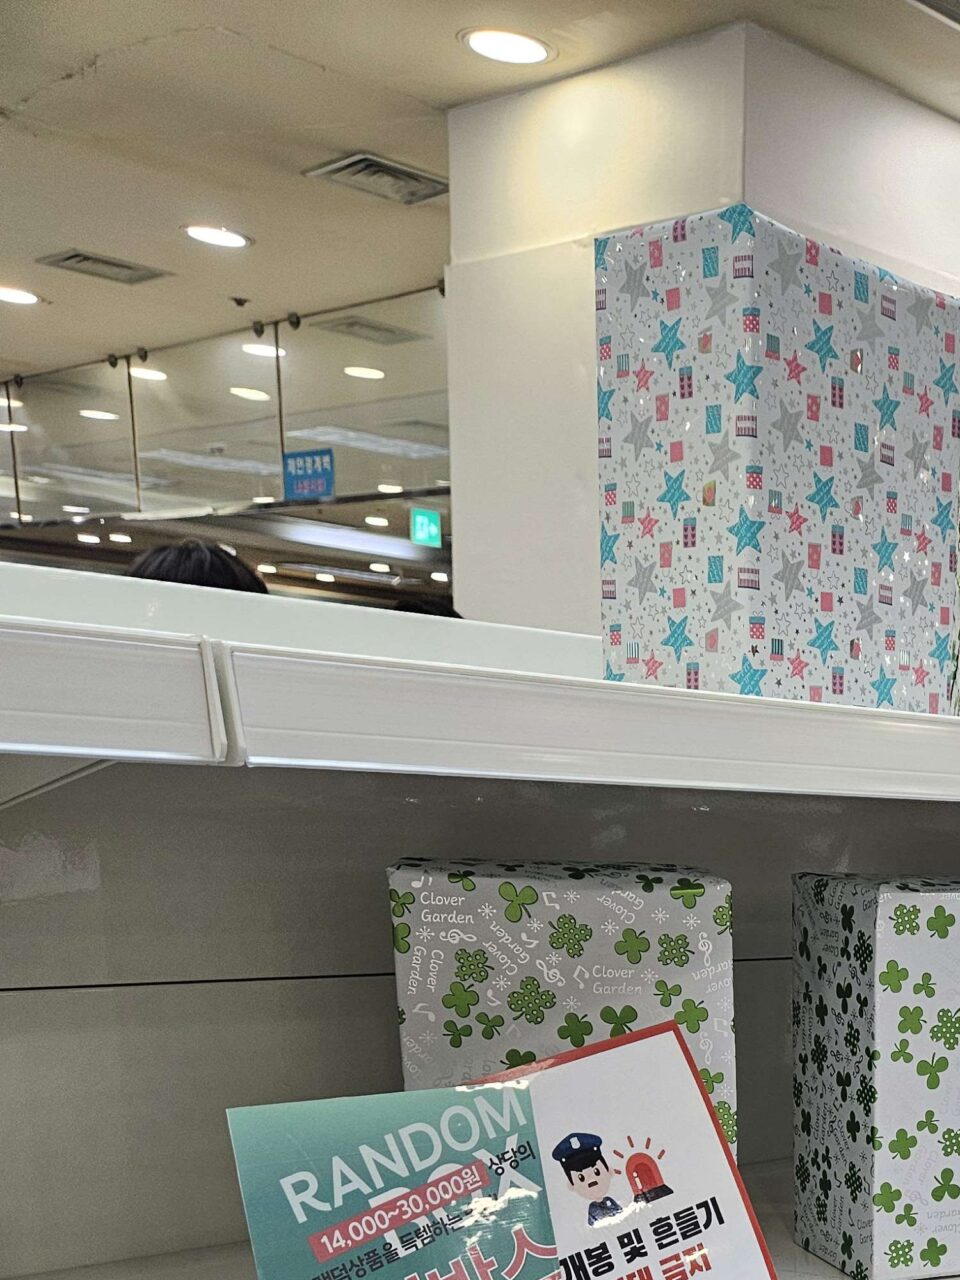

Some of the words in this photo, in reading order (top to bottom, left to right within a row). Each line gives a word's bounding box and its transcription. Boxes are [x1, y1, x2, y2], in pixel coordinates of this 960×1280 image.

[420, 892, 465, 905] Clover
[421, 909, 475, 924] Garden
[596, 895, 636, 924] Clover
[483, 941, 518, 975] Clover
[490, 921, 530, 964] Garden
[407, 945, 427, 995] Garden
[426, 950, 444, 992] Clover
[592, 965, 635, 978] Clover
[592, 982, 642, 995] Garden
[279, 1086, 528, 1225] RANDOM
[320, 1165, 483, 1254] 14,000~30,000원
[488, 1140, 536, 1177] 상당의
[616, 1228, 650, 1264] 및
[649, 1196, 726, 1251] 흔들기
